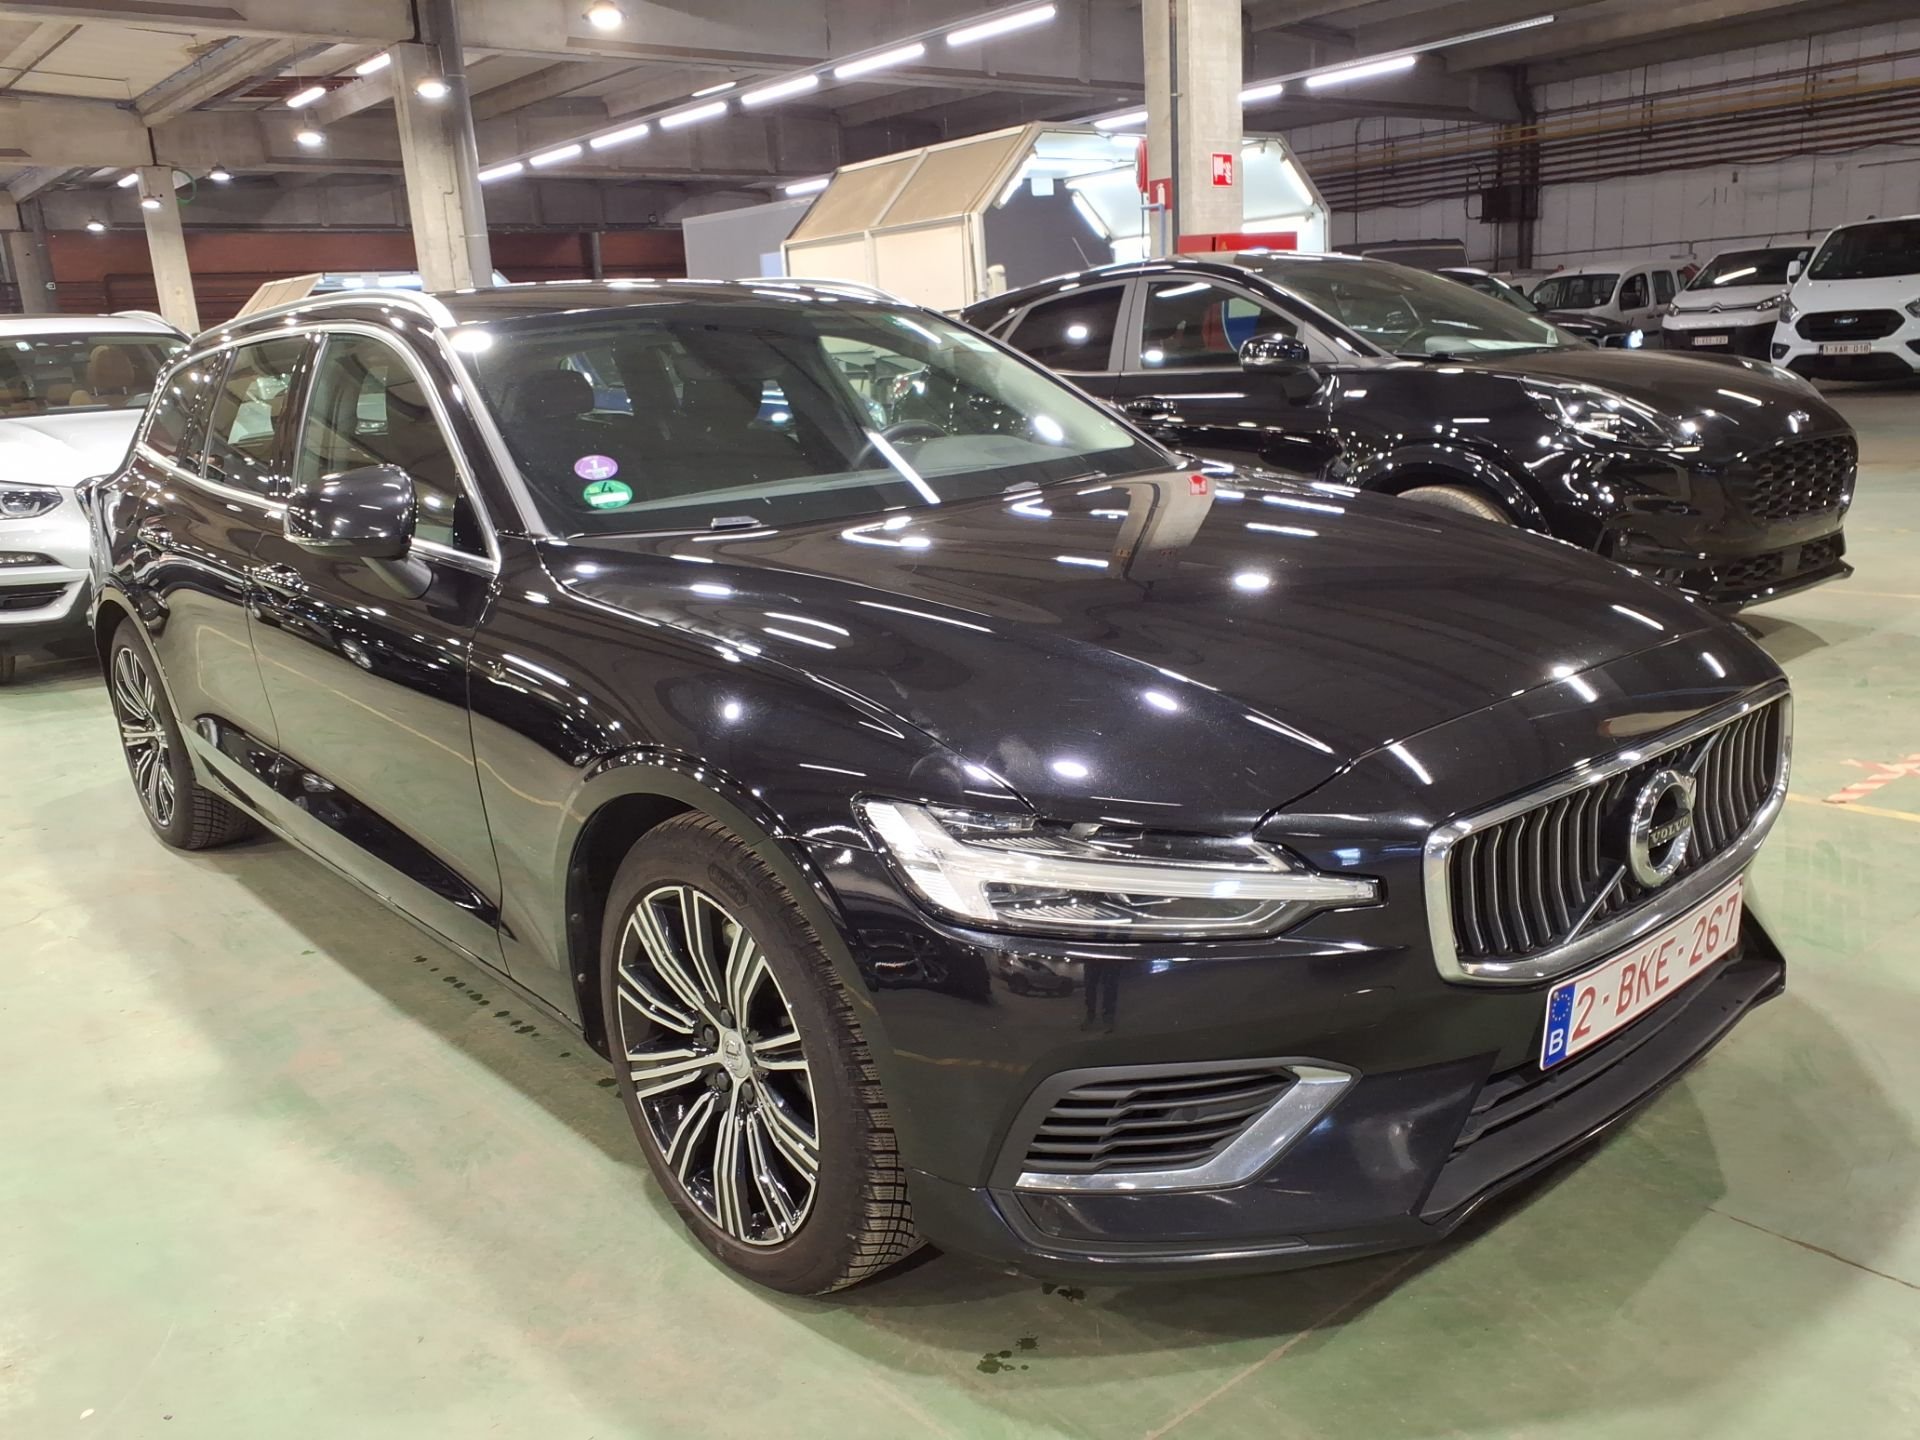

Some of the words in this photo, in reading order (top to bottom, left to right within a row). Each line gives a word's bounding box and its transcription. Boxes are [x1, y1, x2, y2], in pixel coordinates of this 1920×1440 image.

[1650, 817, 1689, 843] VOLVO
[1548, 1028, 1564, 1056] B
[1571, 892, 1741, 1042] 2-BKE-267
